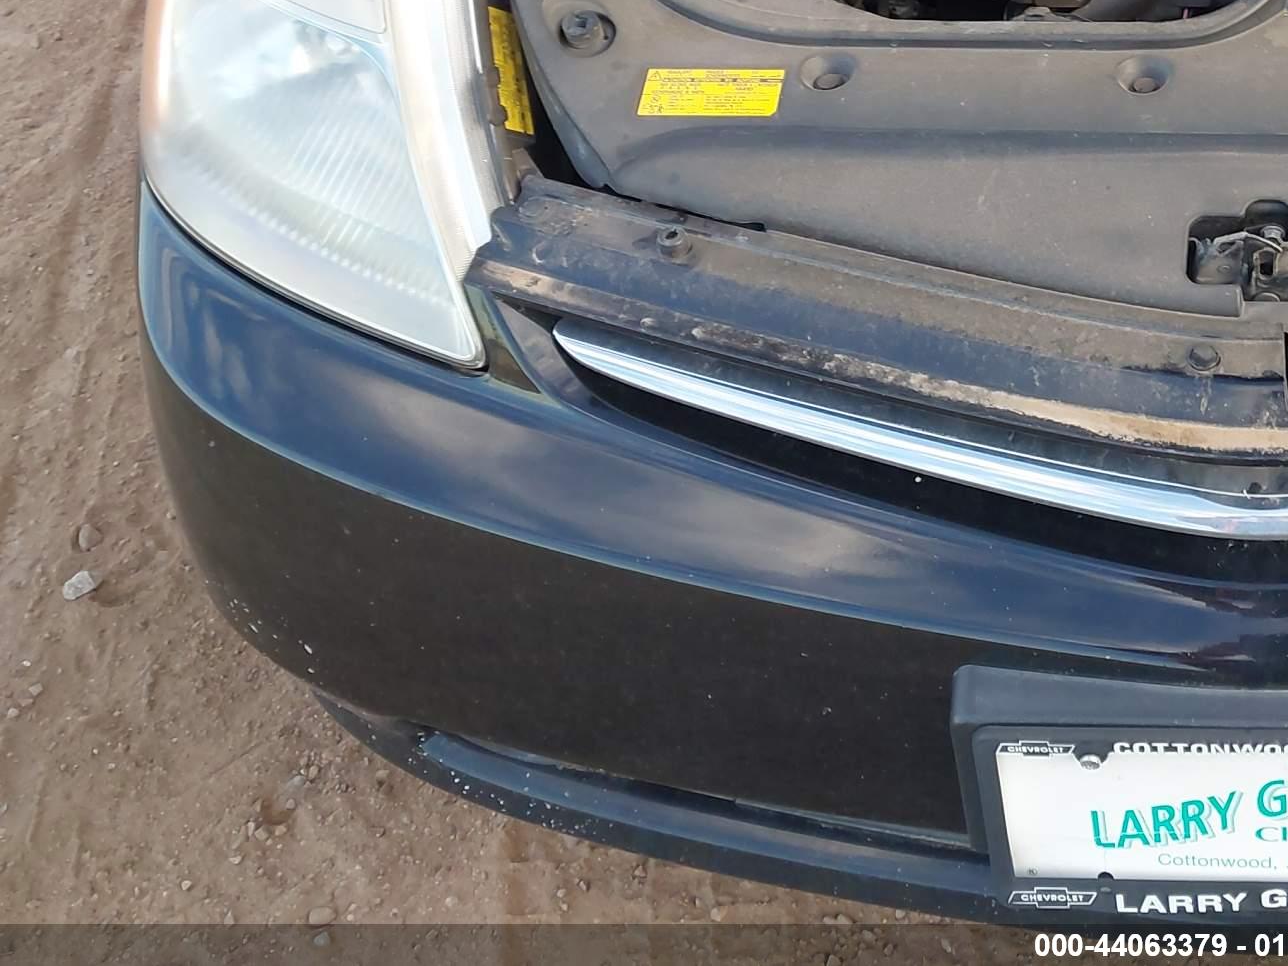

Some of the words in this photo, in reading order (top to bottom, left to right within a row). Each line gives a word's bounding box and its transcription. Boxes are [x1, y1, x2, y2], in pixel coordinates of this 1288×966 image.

[1006, 745, 1064, 754] CHEVROLET
[1090, 790, 1238, 849] LARRY
[1157, 853, 1278, 870] Cottonwood,
[1020, 893, 1084, 903] CHEVROLET
[1115, 891, 1248, 914] LARRY
